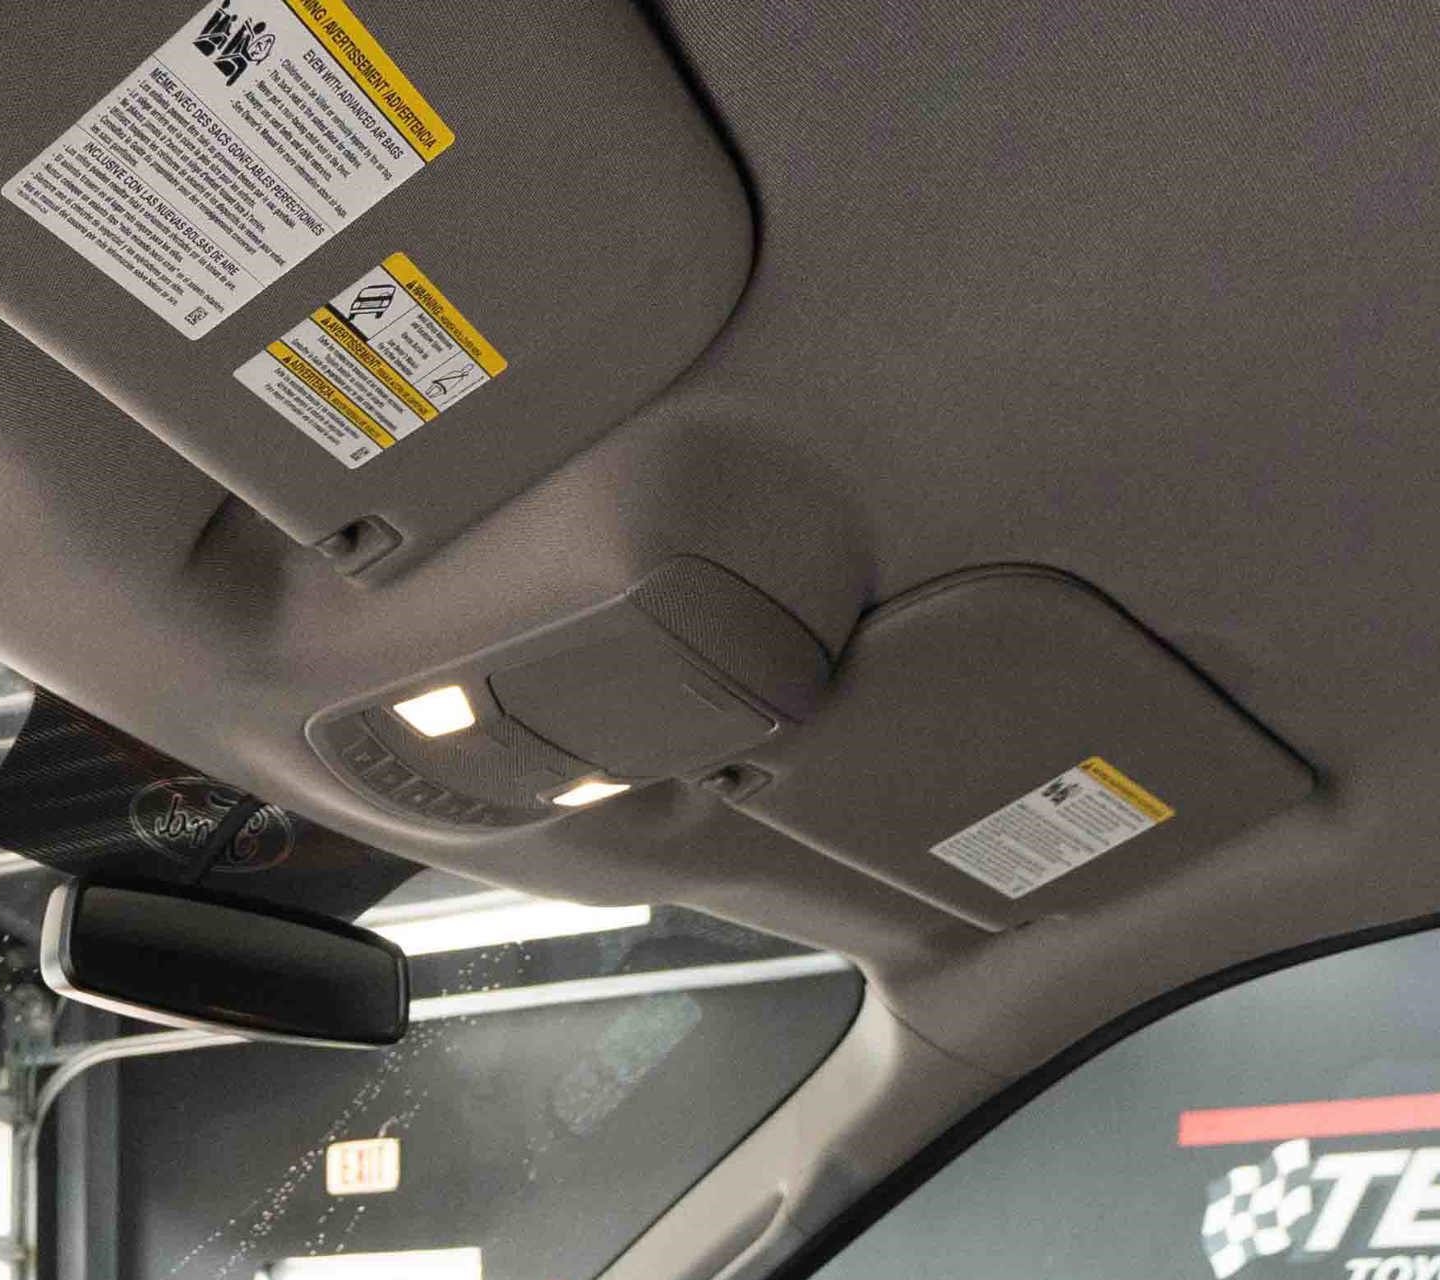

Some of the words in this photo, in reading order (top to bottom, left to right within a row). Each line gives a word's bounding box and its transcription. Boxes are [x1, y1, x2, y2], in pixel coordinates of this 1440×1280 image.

[170, 87, 199, 114] AVEC
[190, 107, 214, 128] DES
[206, 121, 233, 147] SACS
[225, 140, 277, 189] GONFLABLES
[301, 48, 327, 75] EVEN
[320, 69, 344, 93] WITH
[336, 87, 377, 130] ADVANCED
[369, 124, 388, 142] AIR
[380, 136, 405, 160] BAGS
[81, 140, 128, 180] INCLUSIVE
[121, 174, 145, 194] CON
[138, 189, 159, 207] LAS
[153, 202, 187, 231] NUEVAS
[181, 226, 215, 254] BOLSAS
[208, 249, 225, 263] DE
[218, 258, 240, 276] AIRE
